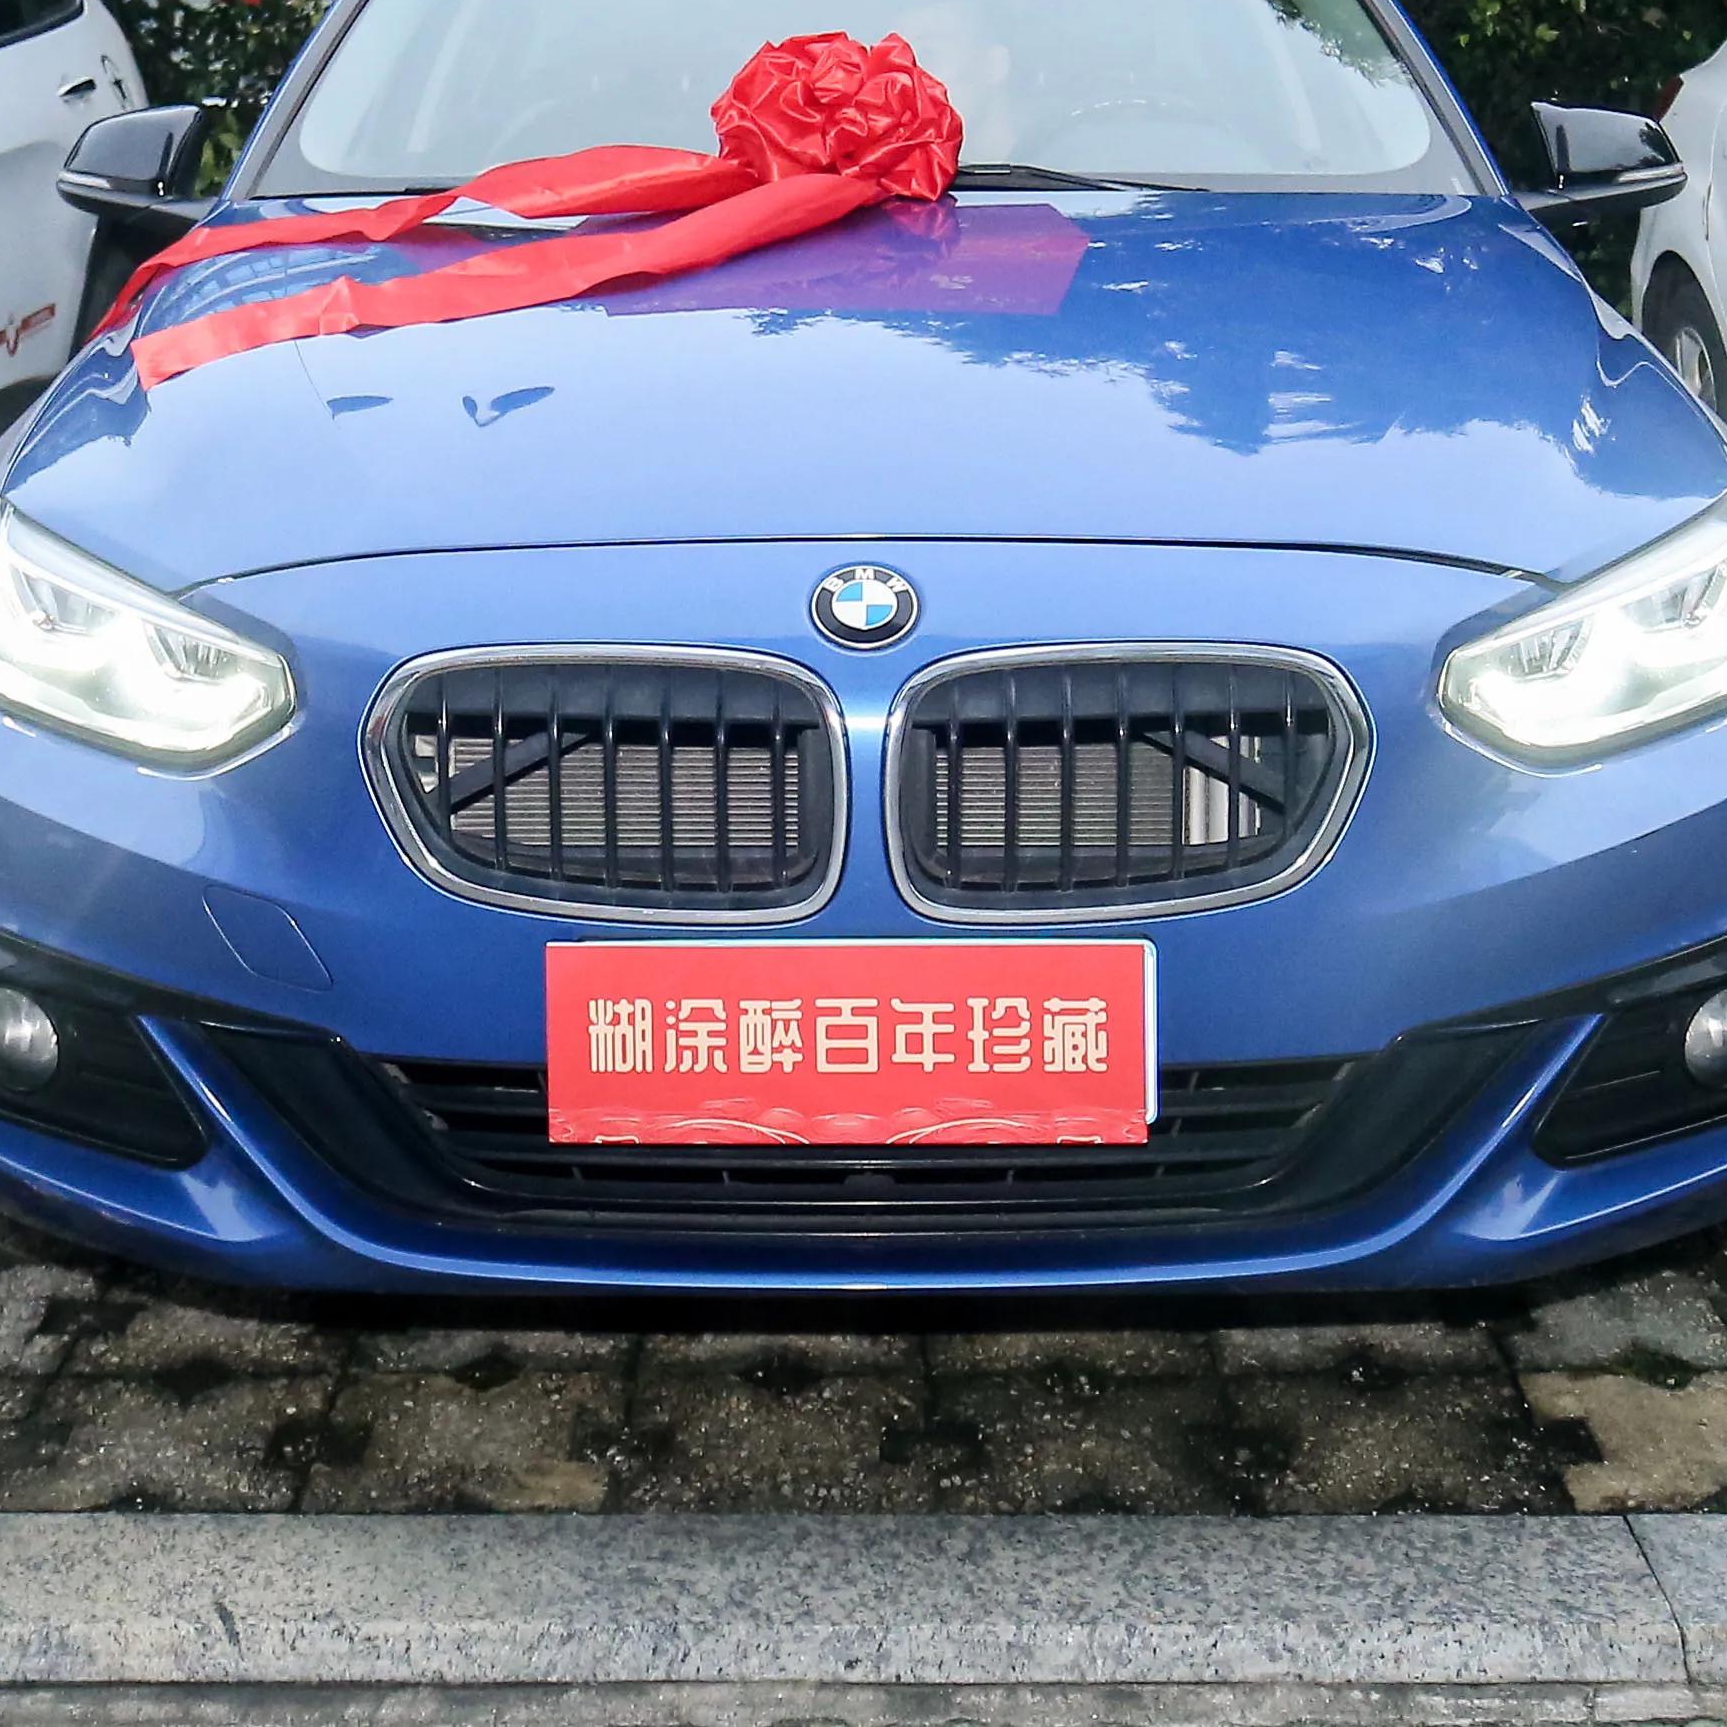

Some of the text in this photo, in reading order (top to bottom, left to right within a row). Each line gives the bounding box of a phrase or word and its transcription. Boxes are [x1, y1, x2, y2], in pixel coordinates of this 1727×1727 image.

[823, 567, 908, 593] BMW
[587, 996, 1109, 1074] 糊涂醉百年珍藏
